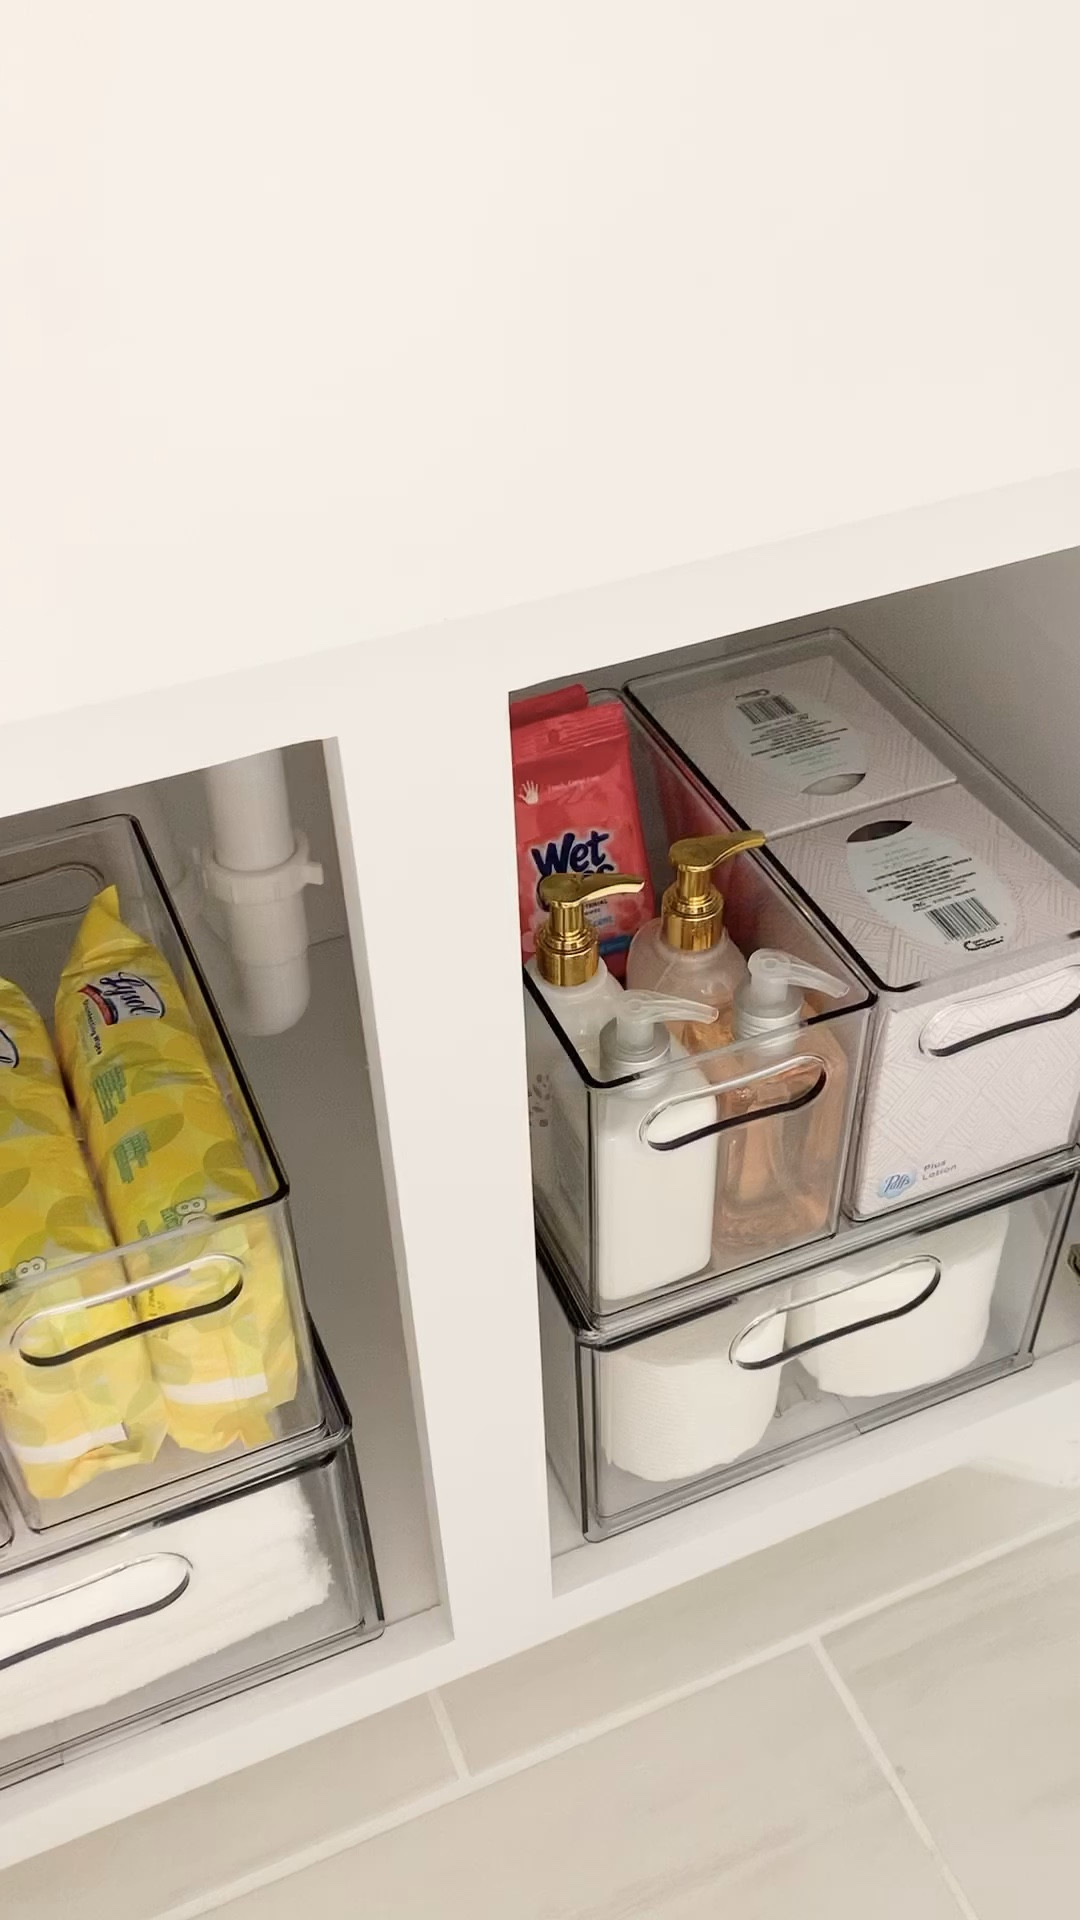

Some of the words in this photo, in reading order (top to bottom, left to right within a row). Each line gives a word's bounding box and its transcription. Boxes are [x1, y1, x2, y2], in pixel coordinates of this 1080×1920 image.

[531, 830, 609, 877] Wet
[99, 971, 162, 1017] Lysol
[883, 1173, 911, 1194] Puffs
